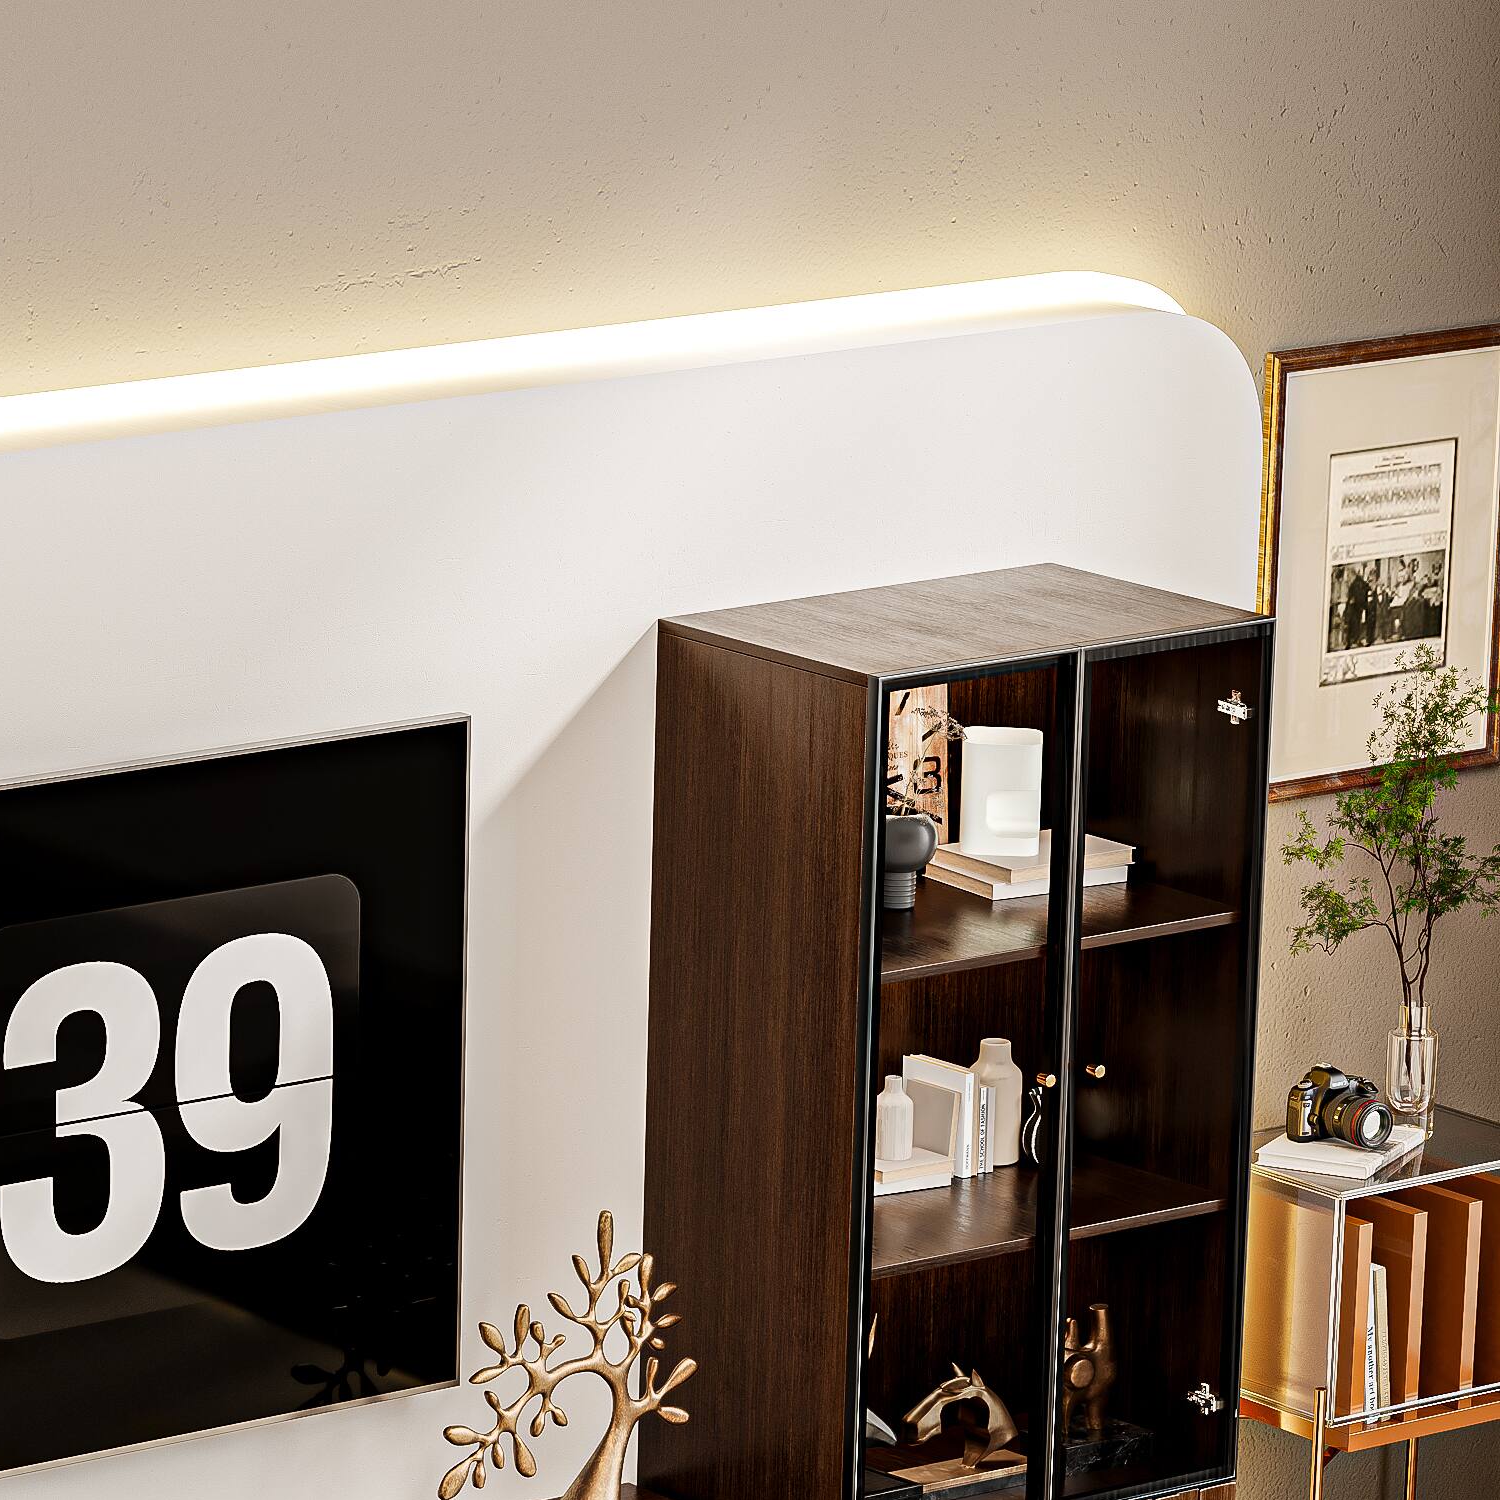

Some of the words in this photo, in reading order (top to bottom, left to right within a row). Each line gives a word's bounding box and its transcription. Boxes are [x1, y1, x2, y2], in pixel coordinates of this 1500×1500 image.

[0, 932, 334, 1284] 39
[980, 1128, 985, 1136] OF
[1367, 1344, 1375, 1379] another
